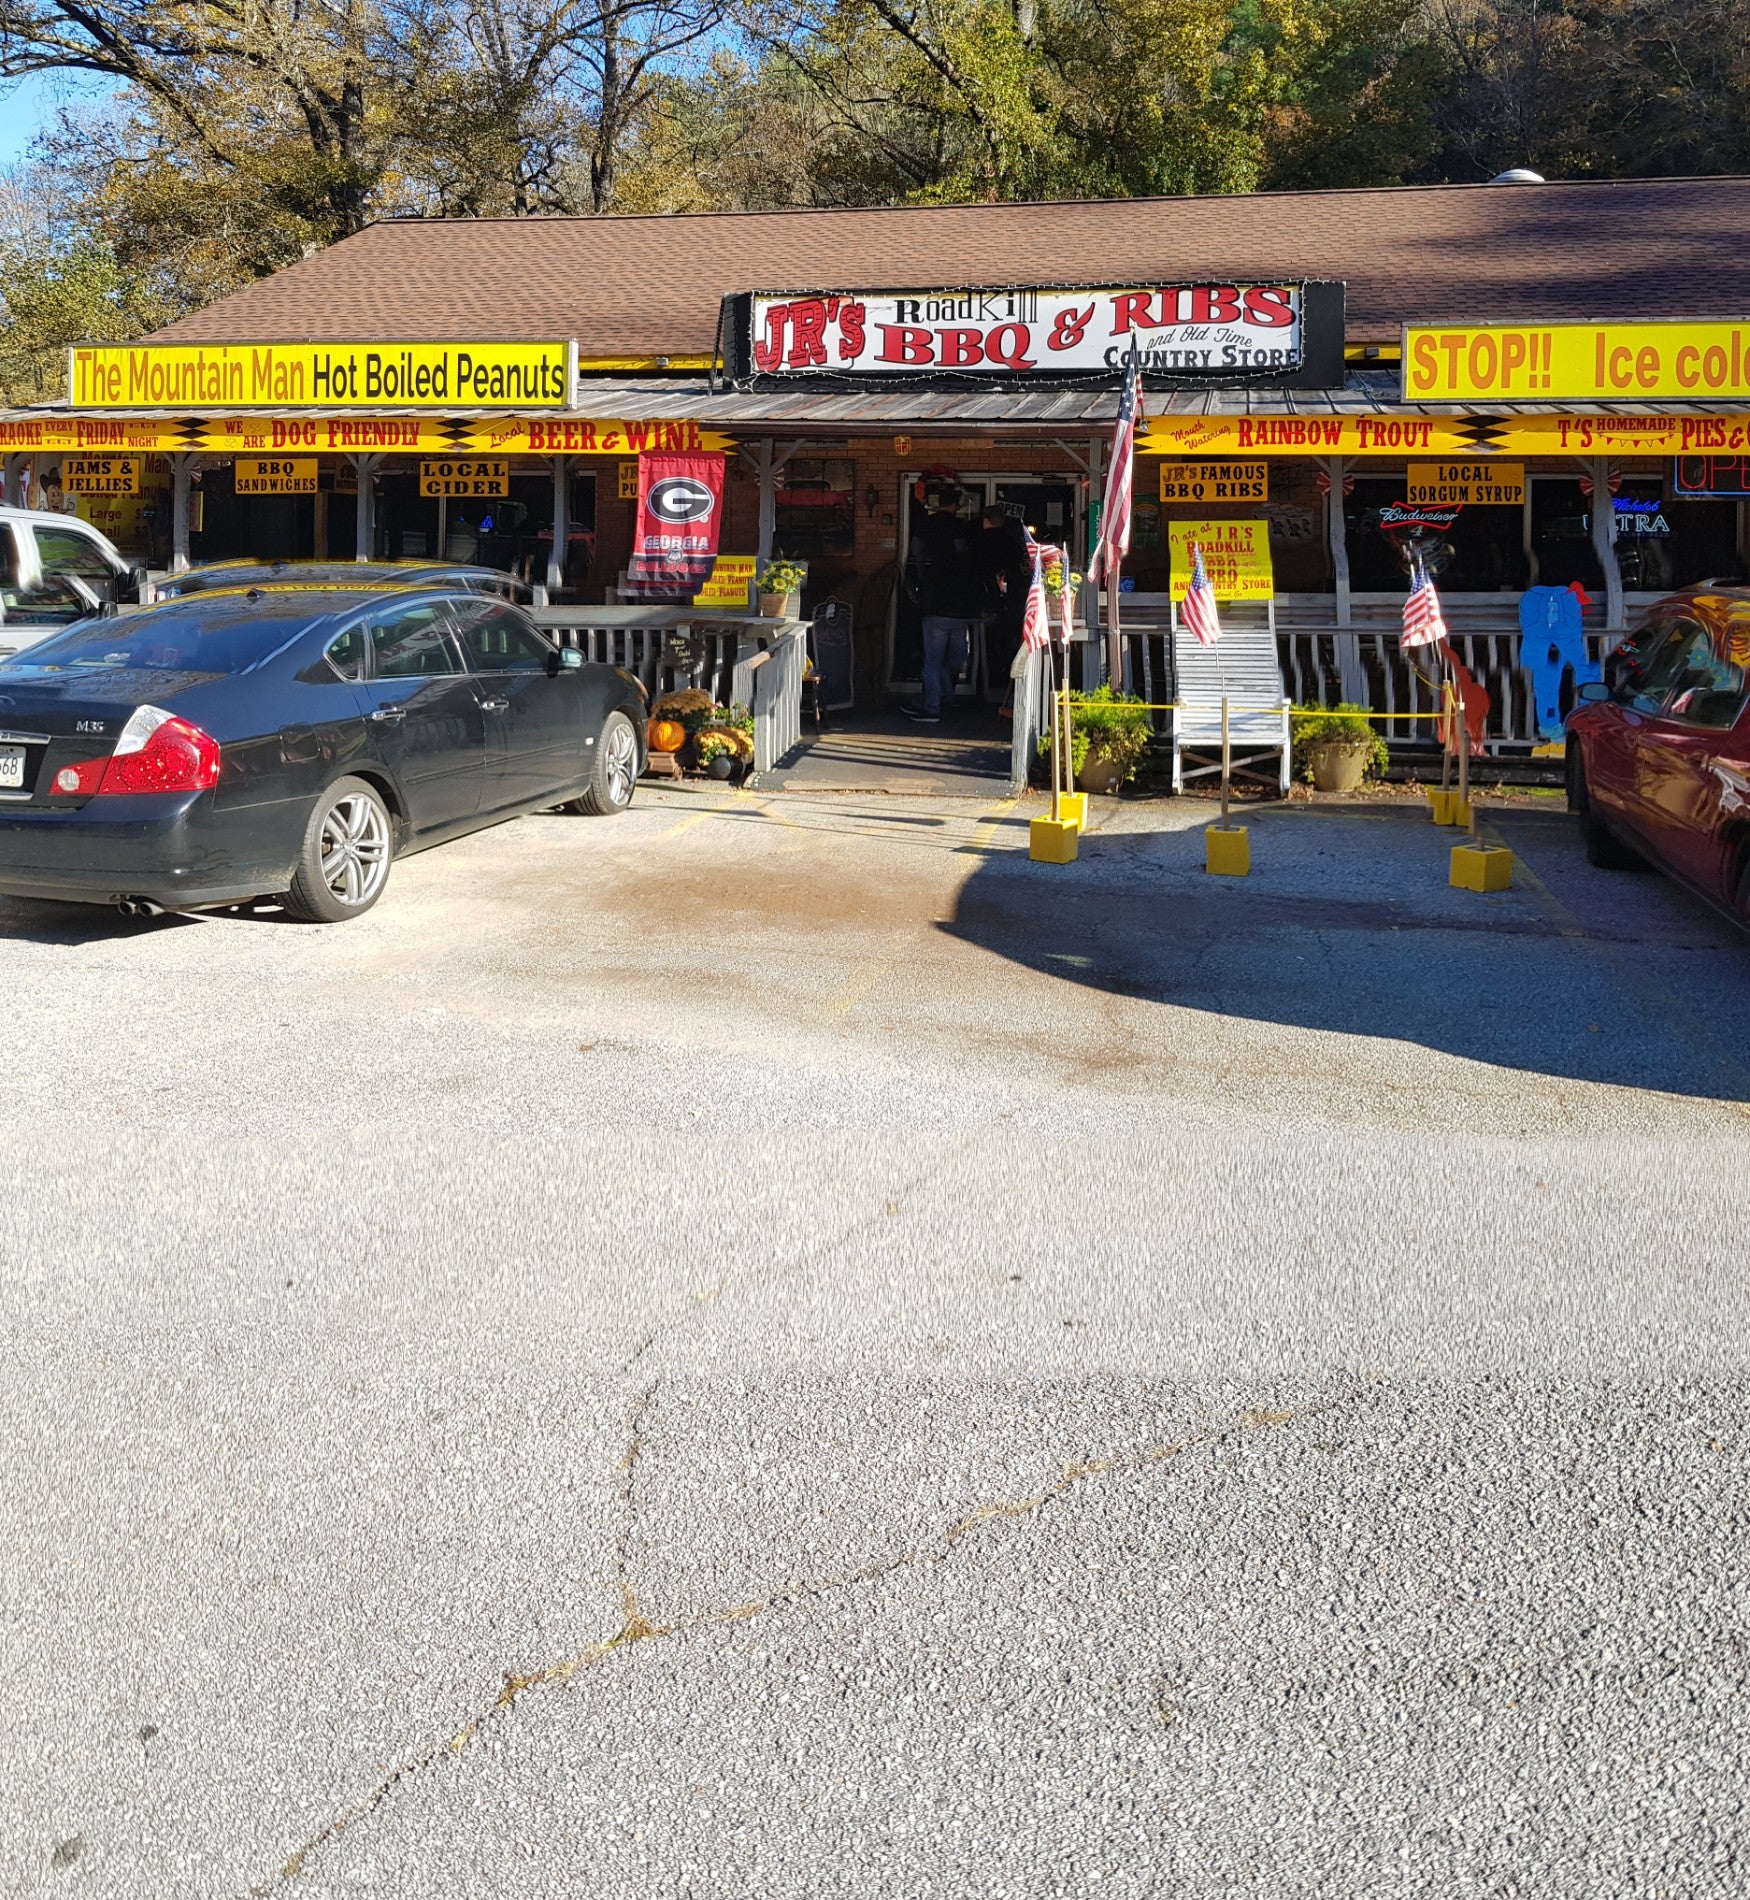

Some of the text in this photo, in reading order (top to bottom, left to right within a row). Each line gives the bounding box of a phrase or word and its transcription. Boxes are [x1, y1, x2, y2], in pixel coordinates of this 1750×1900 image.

[756, 296, 865, 372] JR's
[874, 286, 1297, 369] BBQ & RIBS
[1147, 326, 1253, 350] and Old Time
[1221, 345, 1299, 367] STORE
[1412, 332, 1552, 390] STOP!!
[1595, 332, 1660, 388] Ice
[77, 348, 564, 402] The Mountain Man Hot Boiled Peanuts
[44, 421, 74, 432] EVERY
[76, 421, 125, 447] FRIDAY
[128, 437, 159, 447] NIGHT
[225, 420, 421, 448] WE ARE DOG FRIENDLY
[490, 421, 703, 451] Local BEER & WINE
[1170, 419, 1206, 442] Mouth
[1184, 424, 1231, 450] Watering
[1238, 419, 1433, 448] RAINBOW TROUT
[1596, 417, 1676, 431] HOMEMADE
[1680, 417, 1726, 450] PIES
[1729, 426, 1744, 449] &
[67, 461, 133, 475] JAMS &
[257, 461, 295, 478] BBQ
[423, 463, 505, 477] LOCAL
[1200, 465, 1266, 481] FAMOUS
[1438, 466, 1492, 482] LOCAL
[68, 478, 133, 492] JELLIES
[237, 478, 316, 492] SANDWICHES
[426, 481, 503, 495] CIDER
[1164, 483, 1263, 500] BBQ RIBS
[1409, 485, 1522, 502] SORGUM SYRUP
[90, 506, 122, 522] Large
[1379, 507, 1459, 521] Budweiser
[1182, 528, 1198, 541] ate
[1200, 522, 1212, 534] at
[643, 535, 709, 550] GEORGIA
[636, 561, 707, 573] BULLDOGS
[1242, 579, 1272, 590] STORE
[76, 720, 104, 733] M35
[0, 757, 18, 775] 68
